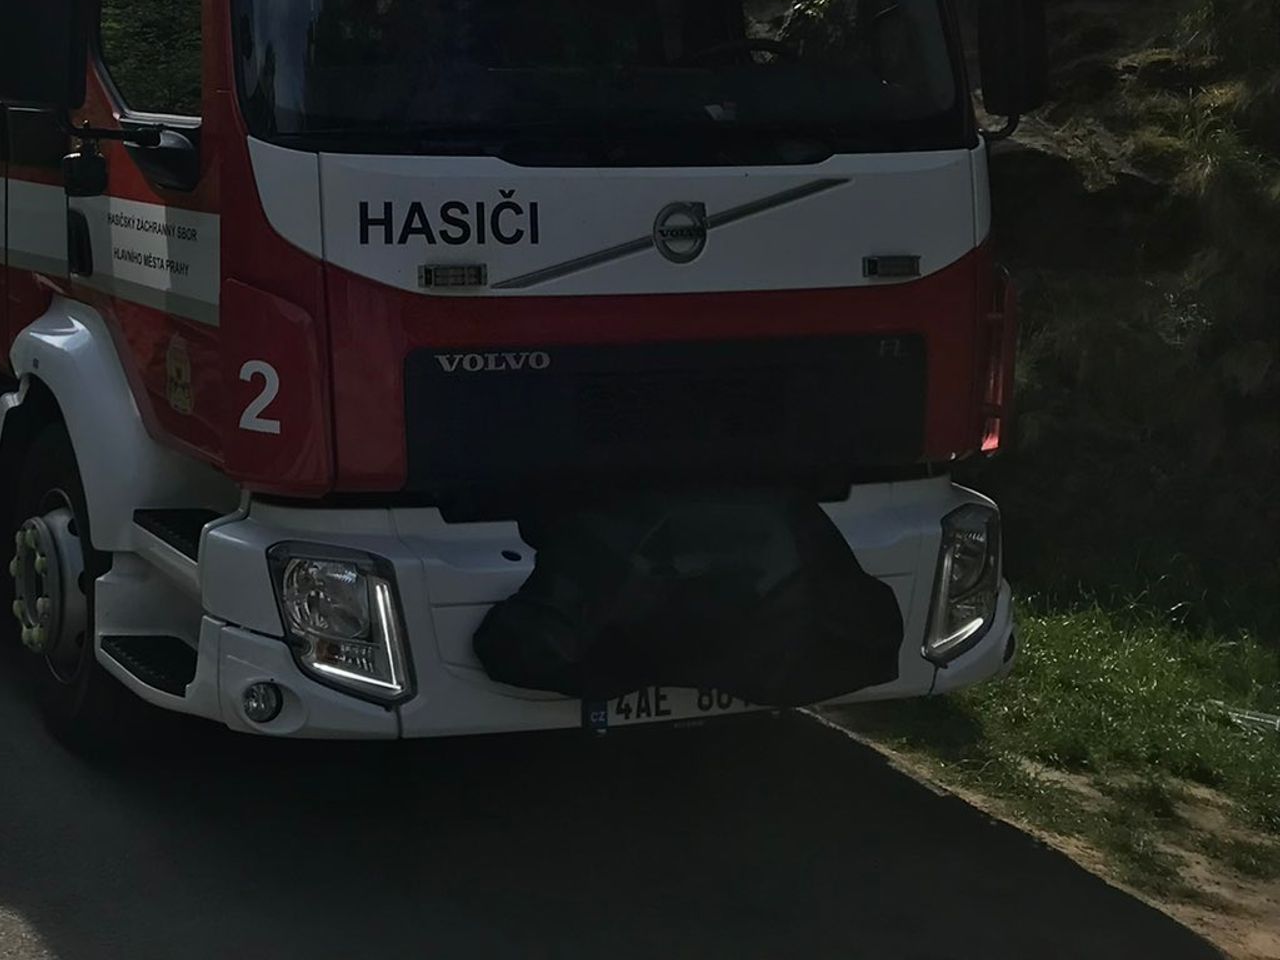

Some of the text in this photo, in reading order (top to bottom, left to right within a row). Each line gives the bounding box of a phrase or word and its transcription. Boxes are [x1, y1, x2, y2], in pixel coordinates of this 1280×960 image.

[107, 211, 136, 229] HASIČSKÝ
[176, 226, 198, 241] SBOR
[358, 189, 540, 245] HASIČI
[113, 247, 190, 276] HLAVNÍHO MĚSTA PRAHY
[433, 351, 551, 373] VOLVO
[239, 359, 281, 435] 2
[590, 711, 605, 722] CZ
[615, 687, 671, 720] 4AE
